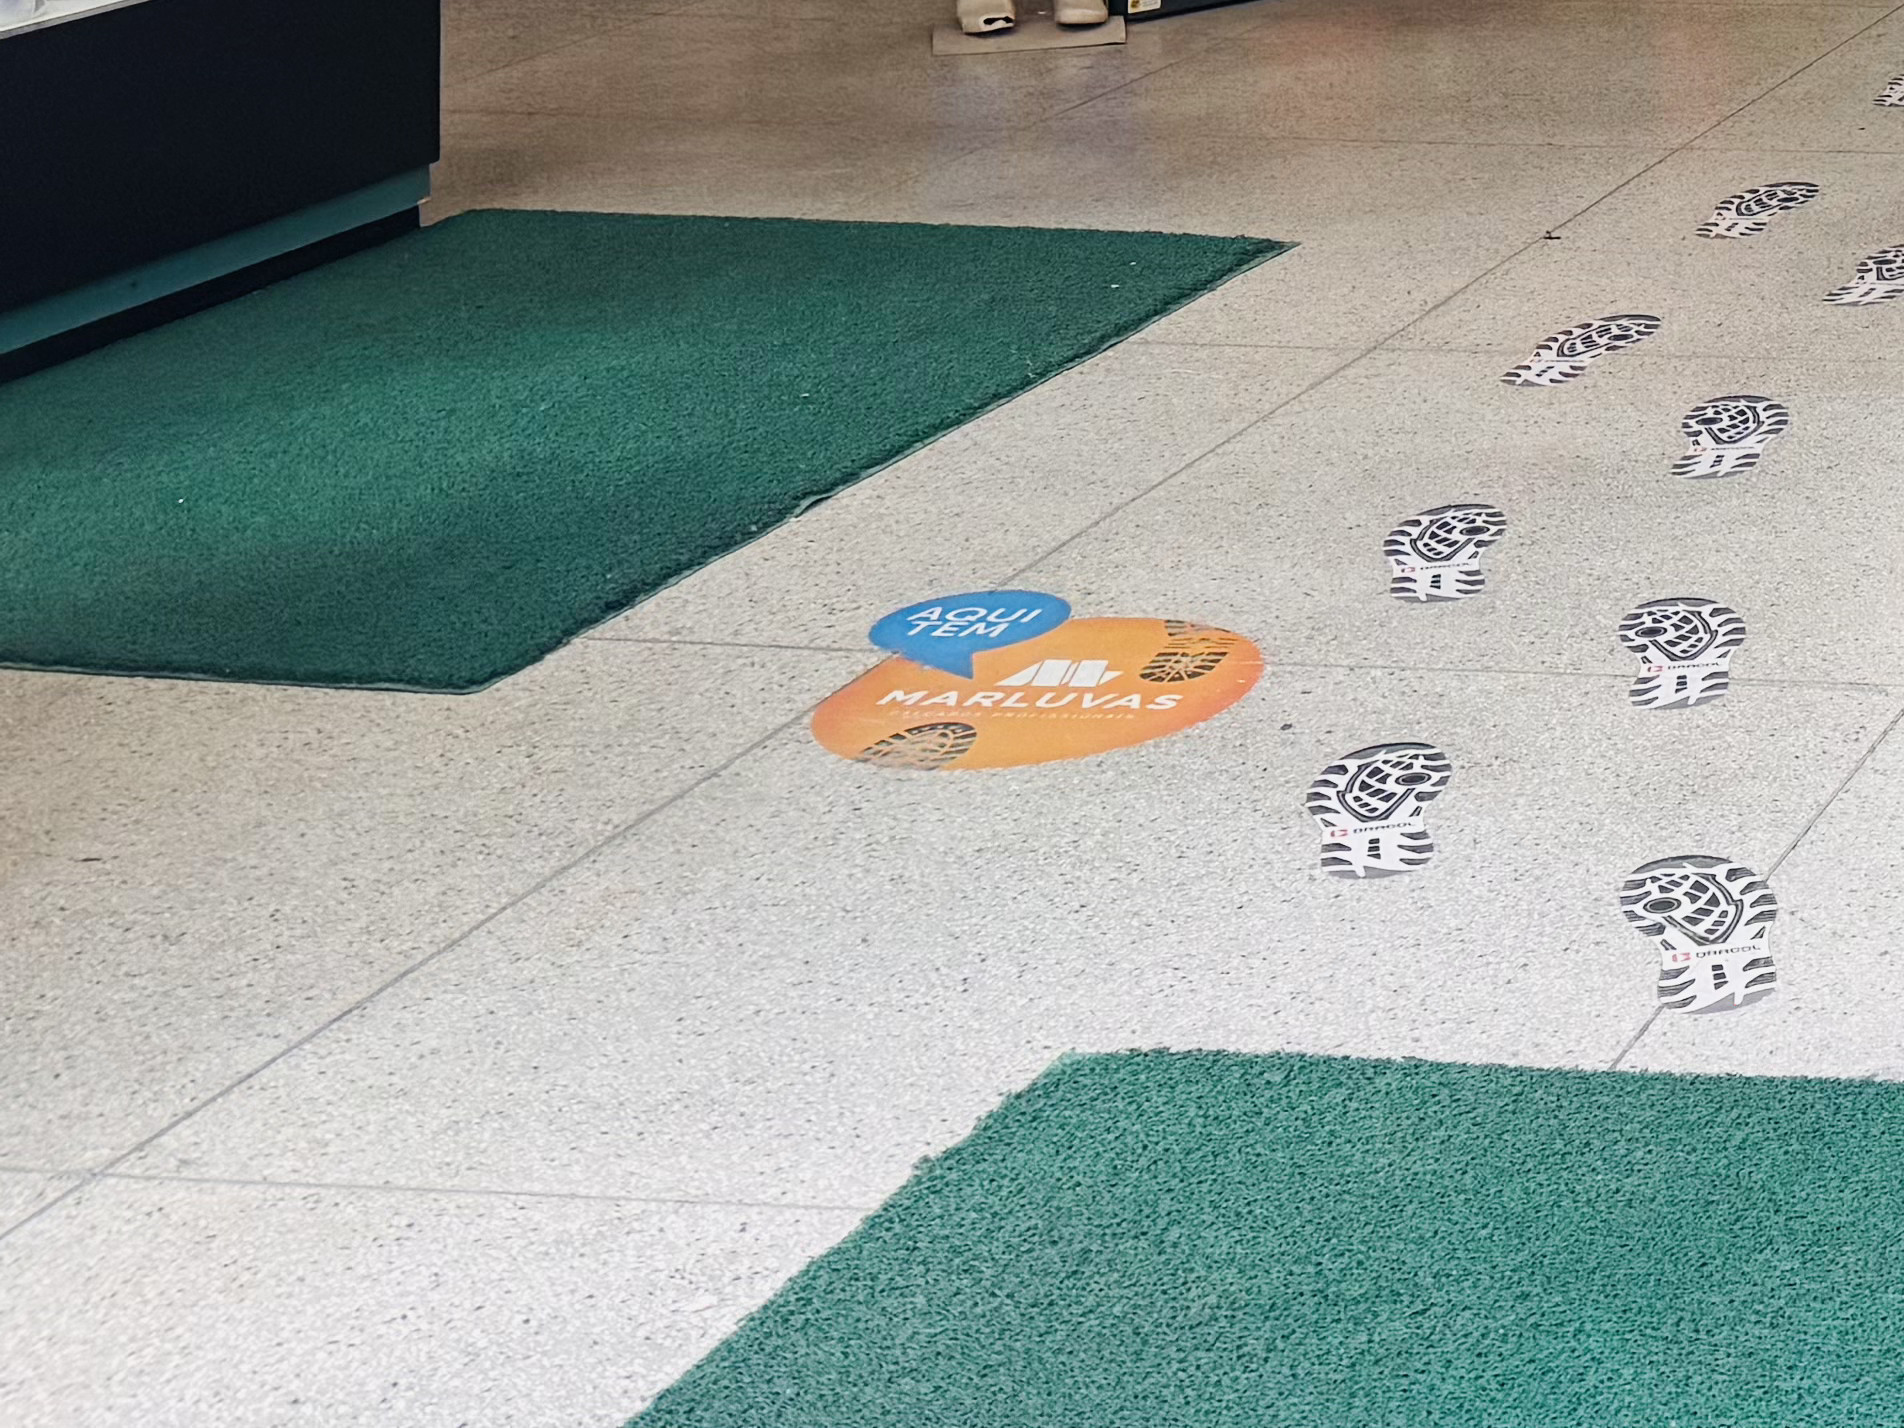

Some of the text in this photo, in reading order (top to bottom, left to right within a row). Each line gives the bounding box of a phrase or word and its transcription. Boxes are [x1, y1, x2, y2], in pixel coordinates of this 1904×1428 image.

[905, 605, 1043, 623] AQUI
[906, 620, 1011, 638] TEM
[875, 688, 1185, 711] MARLUVAS
